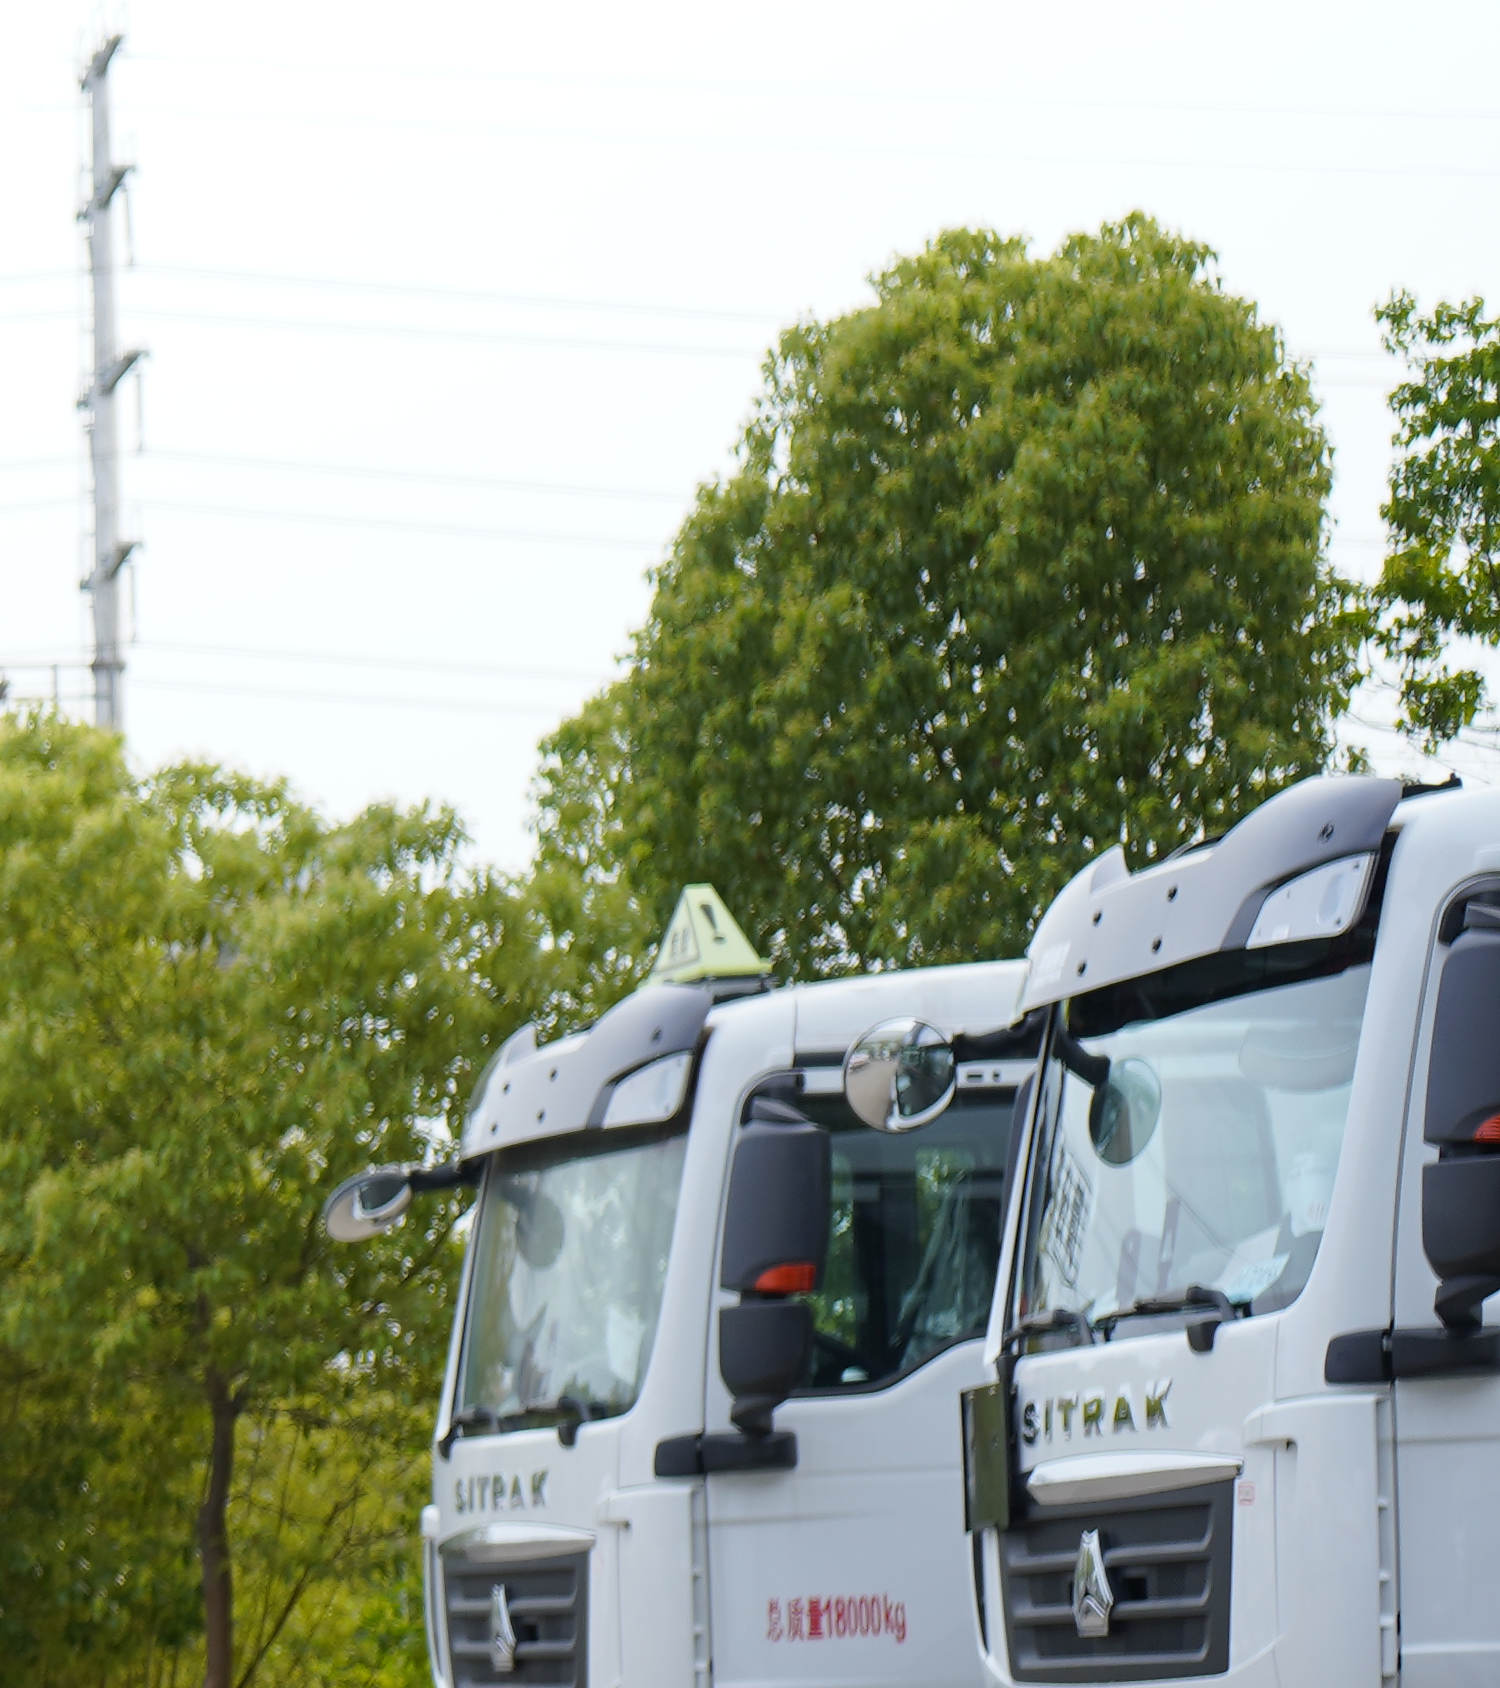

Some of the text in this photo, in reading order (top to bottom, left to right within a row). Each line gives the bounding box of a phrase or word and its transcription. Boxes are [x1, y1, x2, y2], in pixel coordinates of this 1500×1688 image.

[1022, 1375, 1174, 1448] SITRAK
[455, 1468, 549, 1515] SITRAK
[766, 1590, 907, 1645] 总质量18000kg
